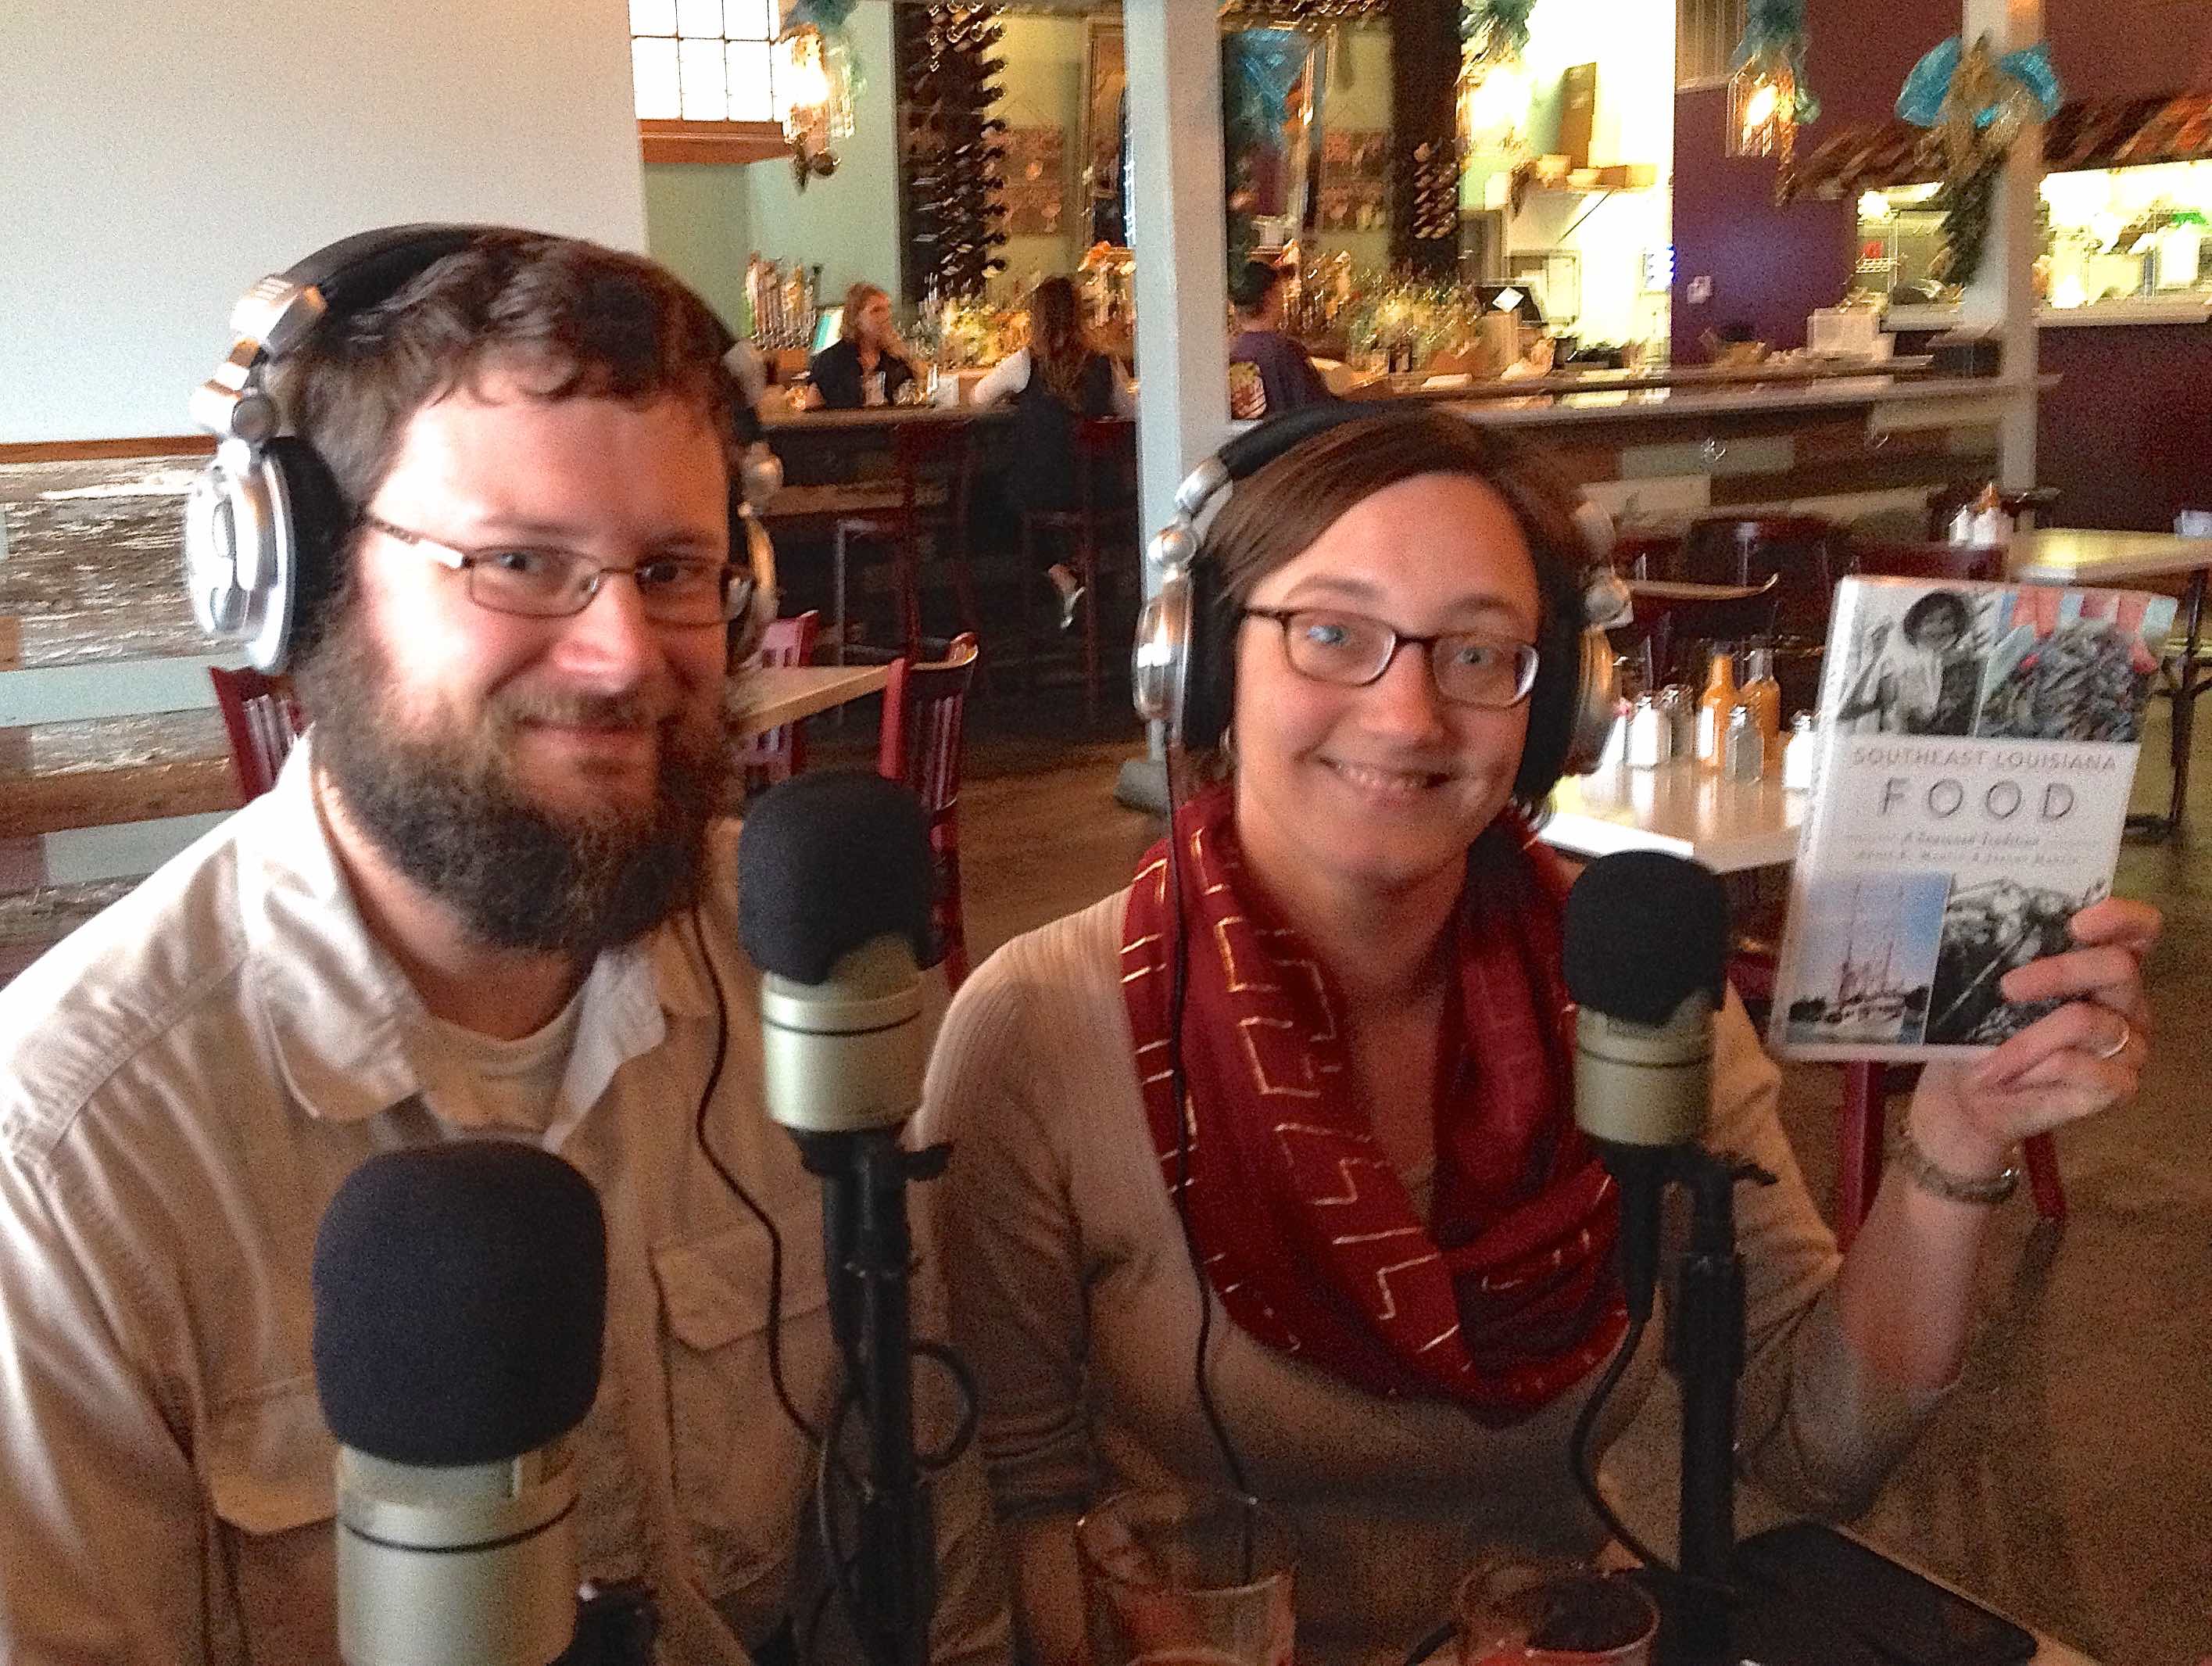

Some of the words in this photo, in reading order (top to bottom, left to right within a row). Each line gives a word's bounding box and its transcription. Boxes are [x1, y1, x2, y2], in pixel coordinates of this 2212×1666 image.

[1852, 747, 1988, 766] SOUTHEAST
[1995, 751, 2116, 770] LOUISIANA
[1881, 776, 2075, 819] FOOD
